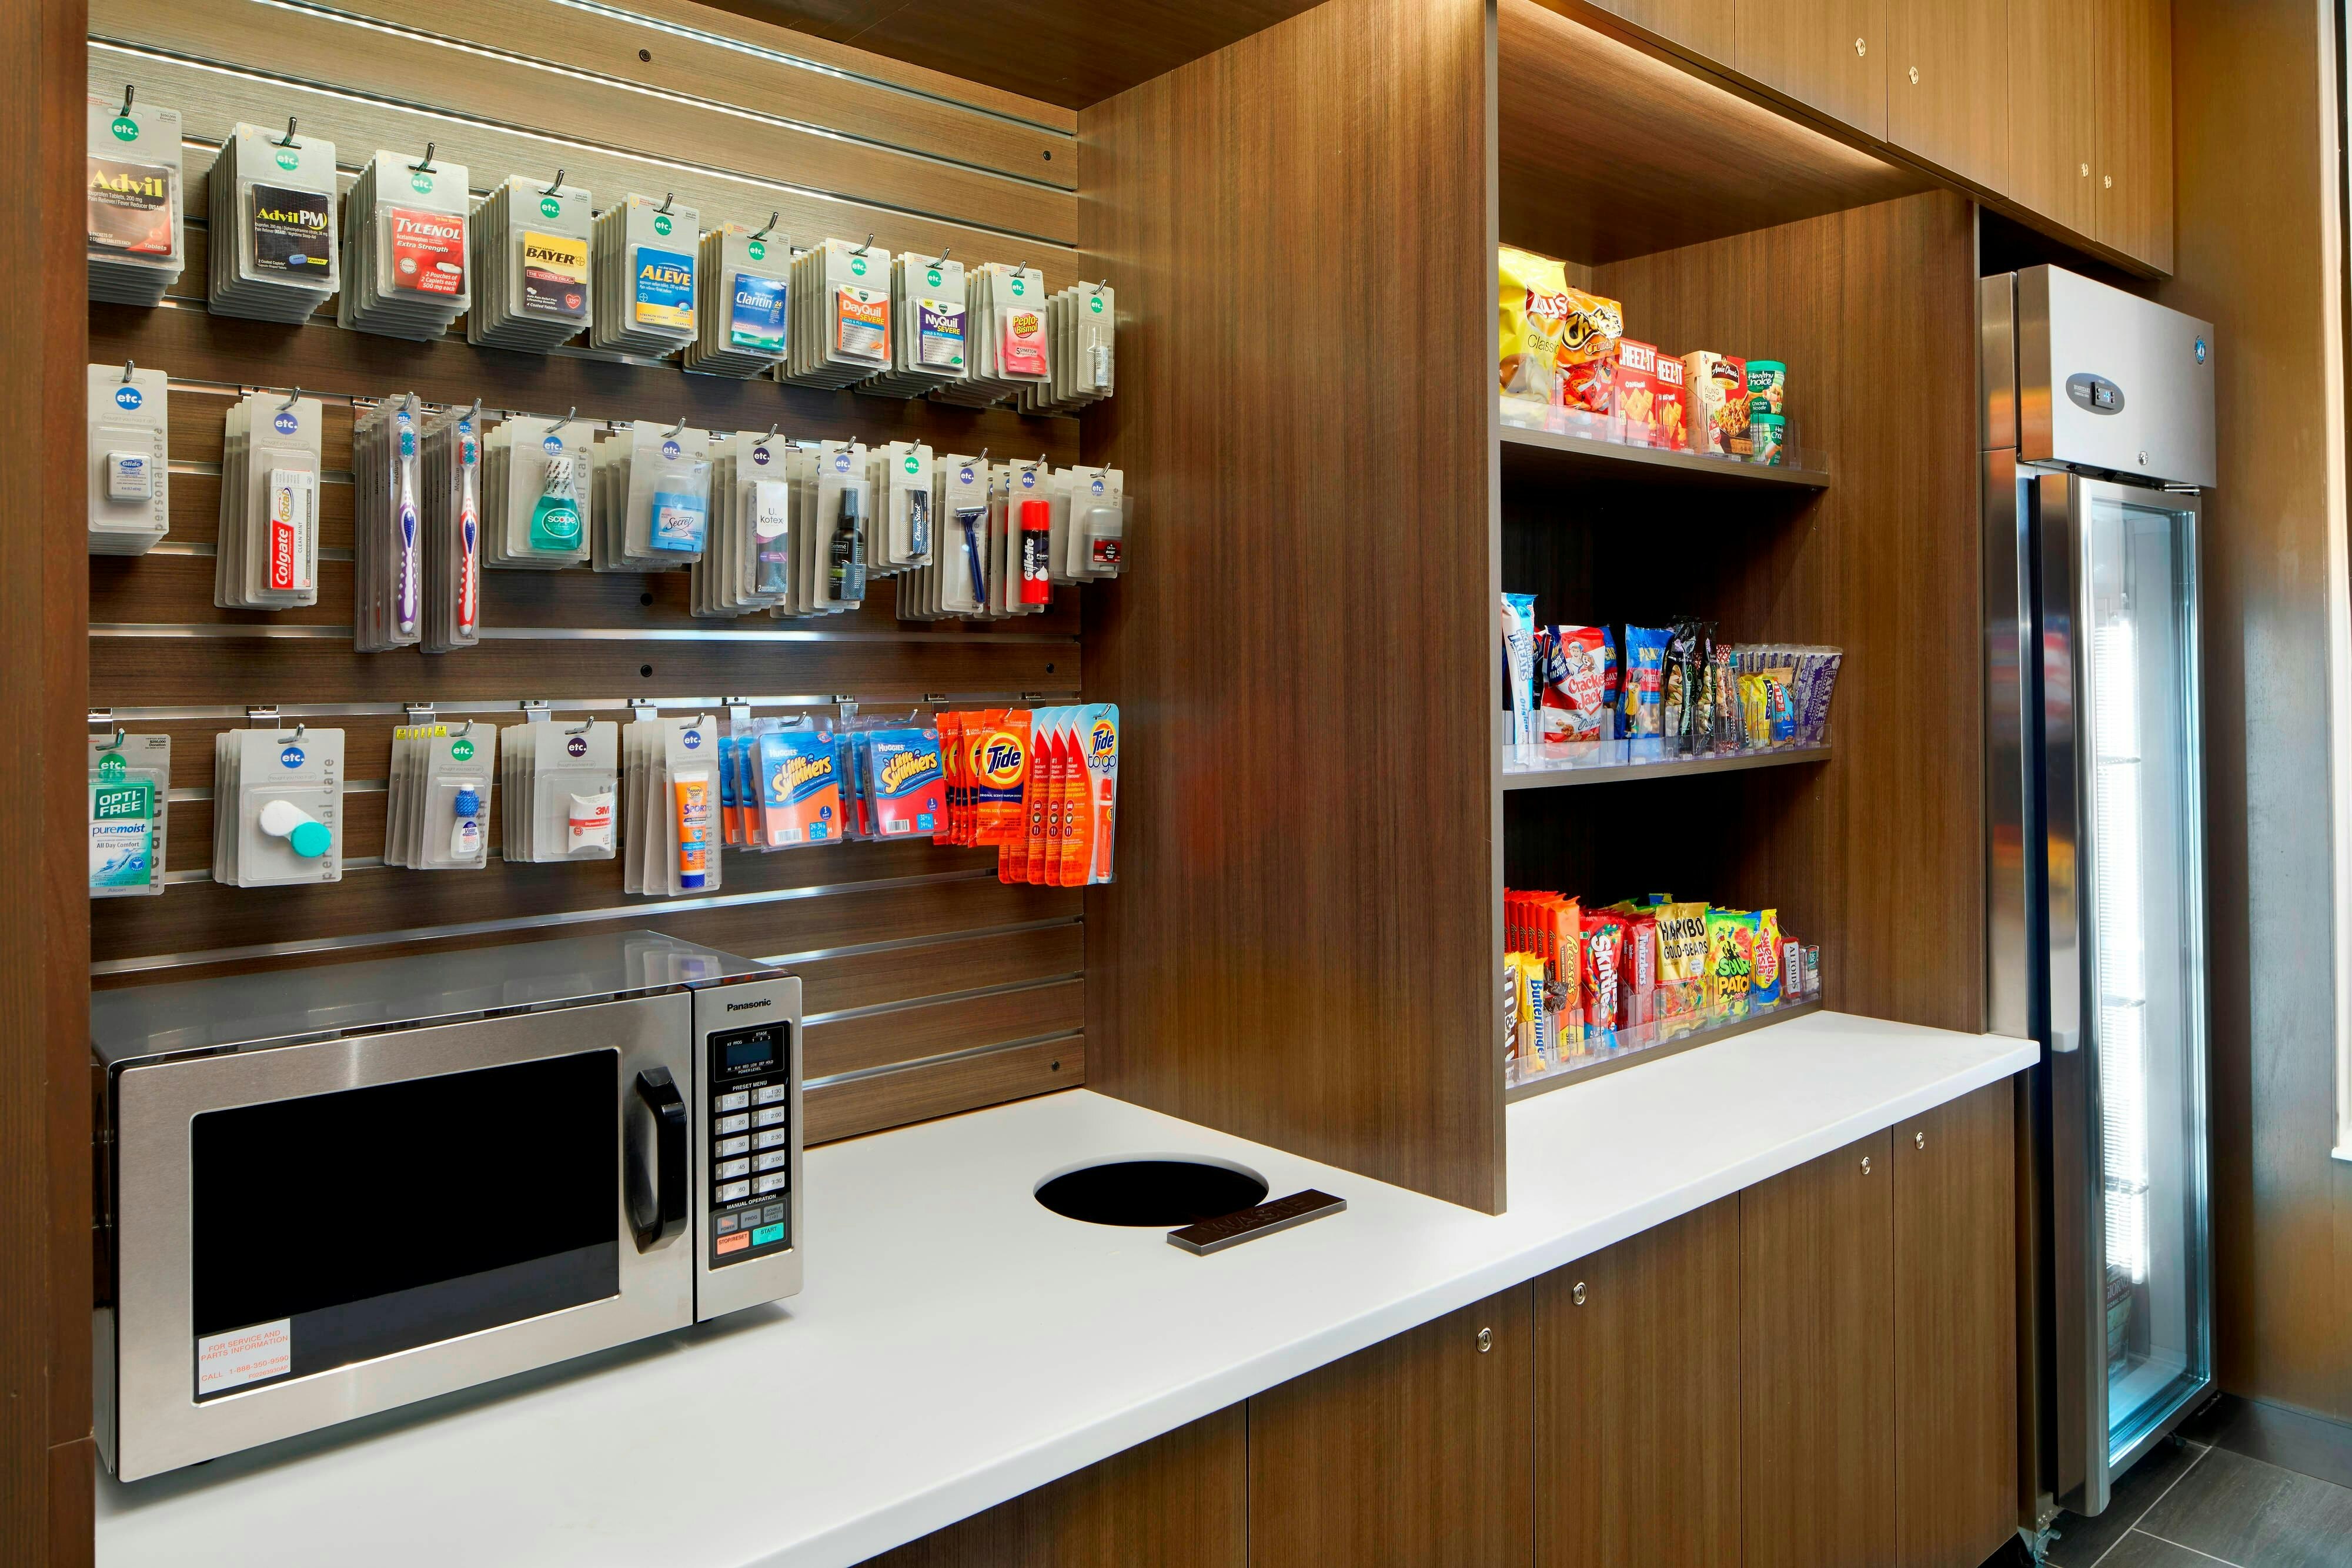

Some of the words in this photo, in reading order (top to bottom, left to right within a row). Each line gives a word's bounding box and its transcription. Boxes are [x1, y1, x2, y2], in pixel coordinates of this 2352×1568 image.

[113, 125, 139, 136] etc.
[277, 155, 299, 165] etc.
[88, 169, 163, 198] Advil
[412, 179, 433, 189] etc.
[542, 204, 559, 213] etc.
[256, 208, 299, 223] Advil
[300, 210, 324, 227] PM
[395, 218, 462, 240] TYLENOL
[656, 222, 671, 231] etc.
[396, 234, 429, 243] Acetaminophen
[417, 243, 449, 253] Strength
[526, 248, 575, 265] BAYER
[750, 247, 764, 256] etc.
[640, 265, 691, 286] ALEVE
[736, 292, 772, 309] Claritin
[843, 300, 881, 317] DayQuil
[860, 314, 884, 325] SEVERE
[926, 314, 958, 327] NyQuil
[937, 326, 960, 335] SEVERE
[1016, 323, 1037, 335] Bismol
[1583, 337, 1615, 356] Crunchy
[1712, 364, 1725, 376] Annie
[1748, 371, 1773, 379] Healthy
[117, 394, 142, 404] etc.
[1705, 386, 1719, 395] KUNG
[275, 419, 298, 429] etc.
[155, 427, 163, 459] care
[663, 446, 680, 455] etc.
[577, 446, 587, 478] care
[152, 466, 166, 531] personal
[280, 492, 290, 518] Total
[547, 515, 576, 526] scope
[666, 516, 694, 530] Secret
[275, 529, 292, 585] Colgate
[1024, 537, 1035, 581] Gillette
[1577, 688, 1602, 710] Jack
[878, 744, 905, 752] HUGGIES
[1092, 729, 1115, 755] Tide
[282, 753, 305, 762] etc.
[769, 749, 797, 757] HUGGIES
[891, 752, 913, 771] Little
[987, 745, 1021, 775] Tide
[101, 761, 125, 770] etc.
[781, 757, 806, 777] Little
[1088, 753, 1100, 768] to
[1102, 755, 1117, 773] go
[323, 758, 335, 795] care
[772, 756, 832, 802] Swimmers
[882, 753, 937, 793] Swimmers
[99, 790, 141, 805] OPTI-
[100, 801, 141, 817] FREE
[596, 805, 609, 815] 3M
[683, 804, 706, 815] SPORT
[93, 823, 146, 837] puremoist
[1659, 917, 1705, 941] HARIBO
[1664, 941, 1708, 959] GOLD-BEARS
[1761, 928, 1776, 983] Swedish
[1565, 934, 1579, 995] Reese's
[1639, 933, 1649, 986] Twizzlers
[1719, 957, 1750, 976] SOUR
[1755, 943, 1766, 975] Fish
[1591, 935, 1613, 1019] Skittles
[727, 998, 771, 1012] Panasonic
[733, 1083, 751, 1091] PRESET
[727, 1200, 748, 1209] MANUAL
[749, 1194, 776, 1205] OPERATION
[1200, 1197, 1314, 1236] WASTE
[719, 1233, 747, 1245] STOP/RESET
[760, 1226, 777, 1235] START
[201, 1349, 228, 1361] PARTS
[231, 1335, 288, 1354] INFORMATION
[209, 1343, 225, 1352] FOR
[228, 1334, 262, 1347] SERVICE
[265, 1330, 280, 1338] AND
[202, 1371, 223, 1381] CALL
[229, 1355, 289, 1375] 1-888-350-9590
